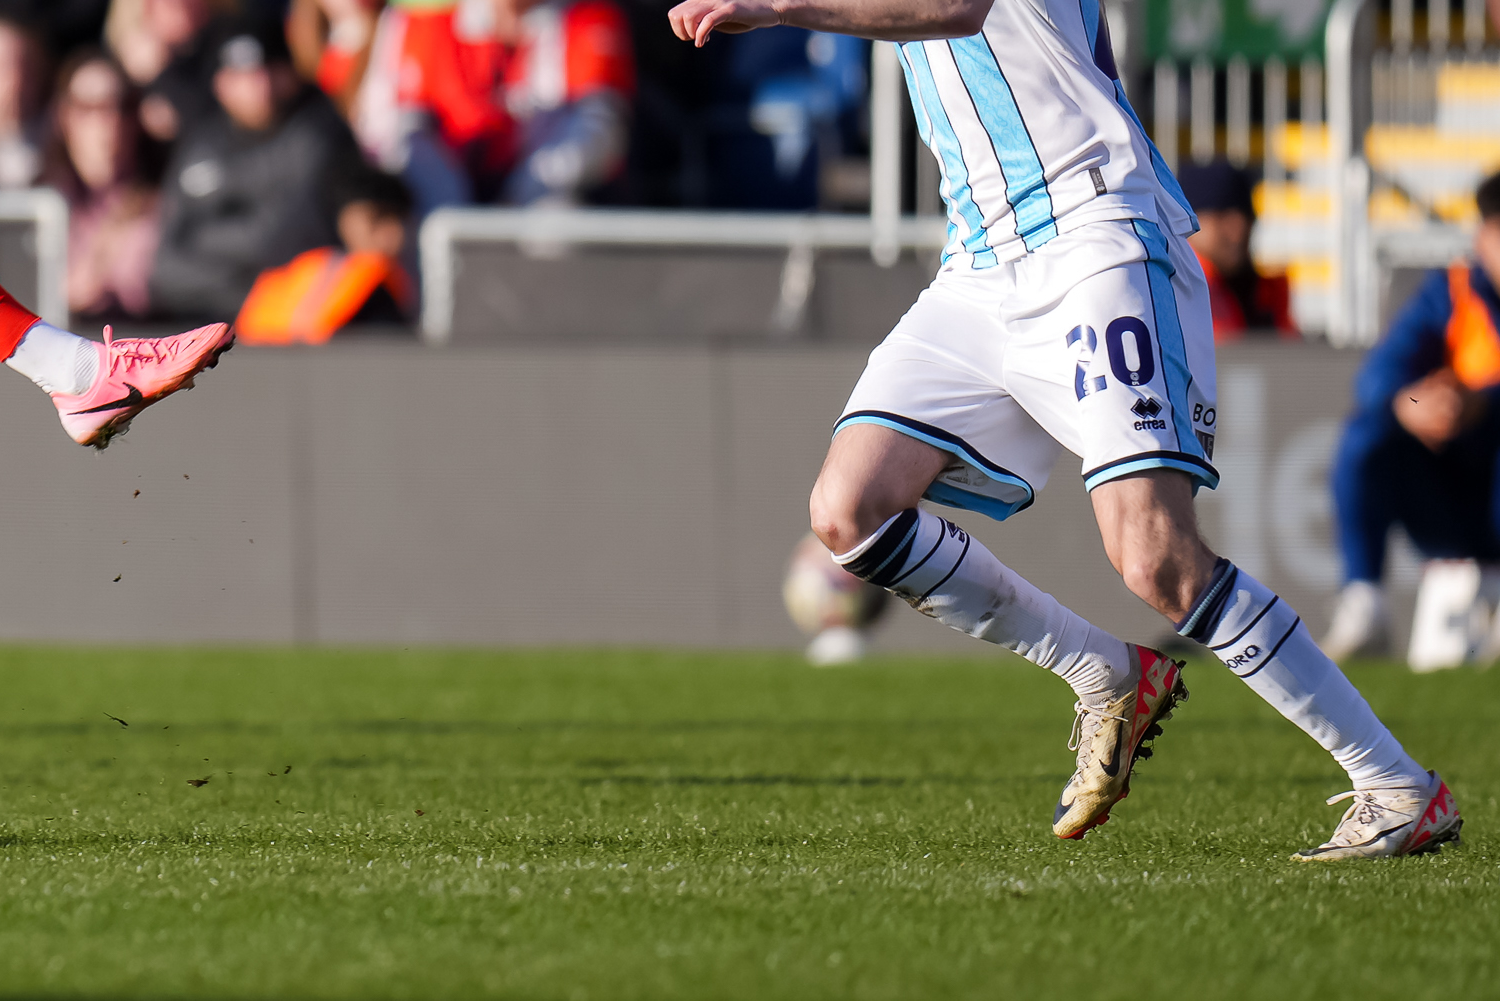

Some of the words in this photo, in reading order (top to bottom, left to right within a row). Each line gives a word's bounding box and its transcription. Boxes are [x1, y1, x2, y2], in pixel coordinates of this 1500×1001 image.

[1066, 315, 1156, 402] 20
[1134, 419, 1167, 431] errea
[1192, 403, 1216, 429] BO
[1223, 645, 1261, 669] ORO
